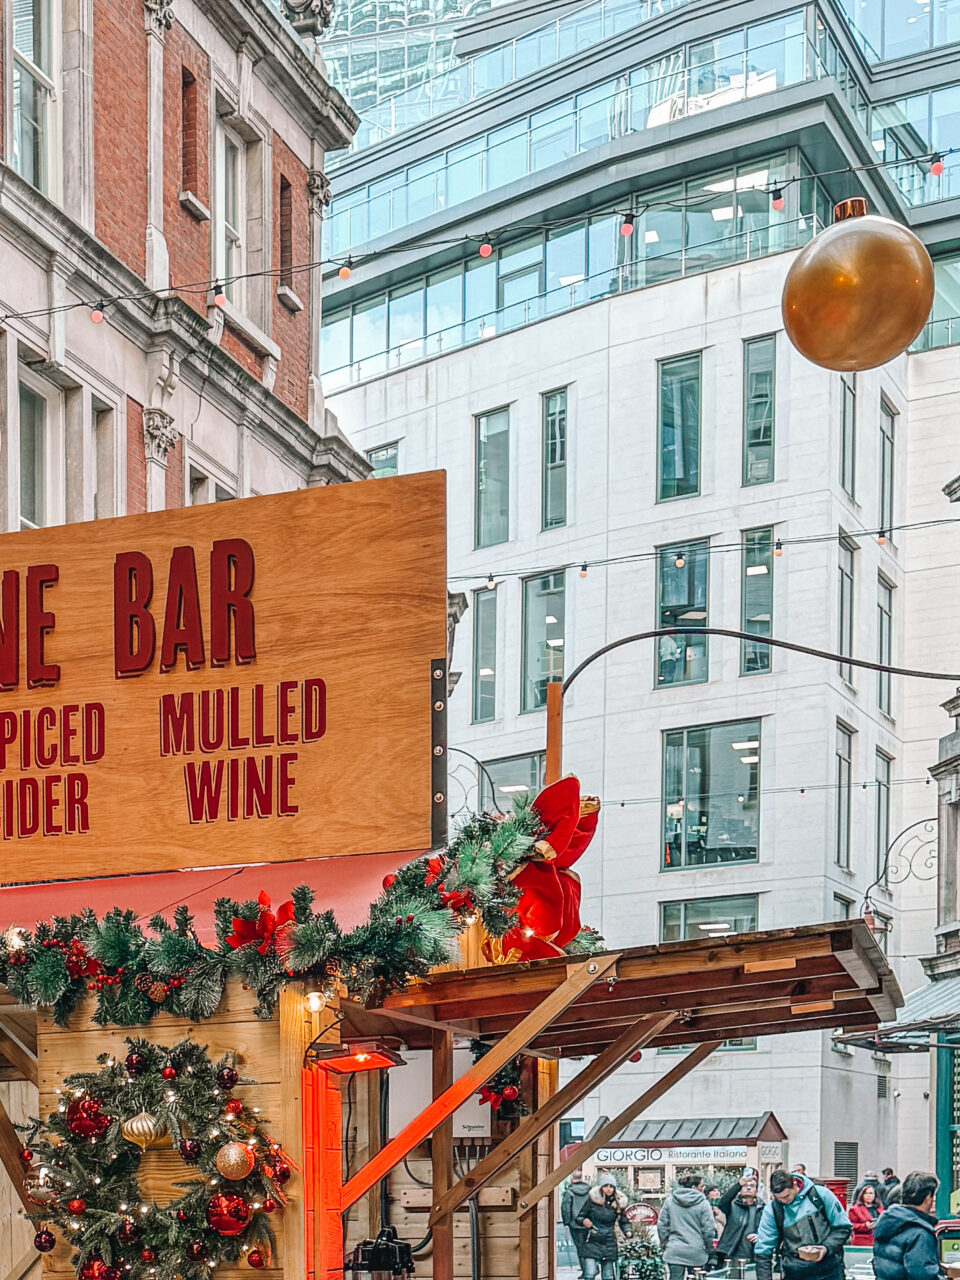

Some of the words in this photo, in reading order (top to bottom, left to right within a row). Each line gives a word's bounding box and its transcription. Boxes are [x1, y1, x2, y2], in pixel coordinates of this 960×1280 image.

[114, 538, 257, 680] BAR
[159, 677, 327, 757] MULLED
[183, 752, 300, 825] WINE
[596, 1148, 662, 1162] GIORGIO
[668, 1149, 712, 1160] Ristorante
[713, 1148, 748, 1159] Italiano
